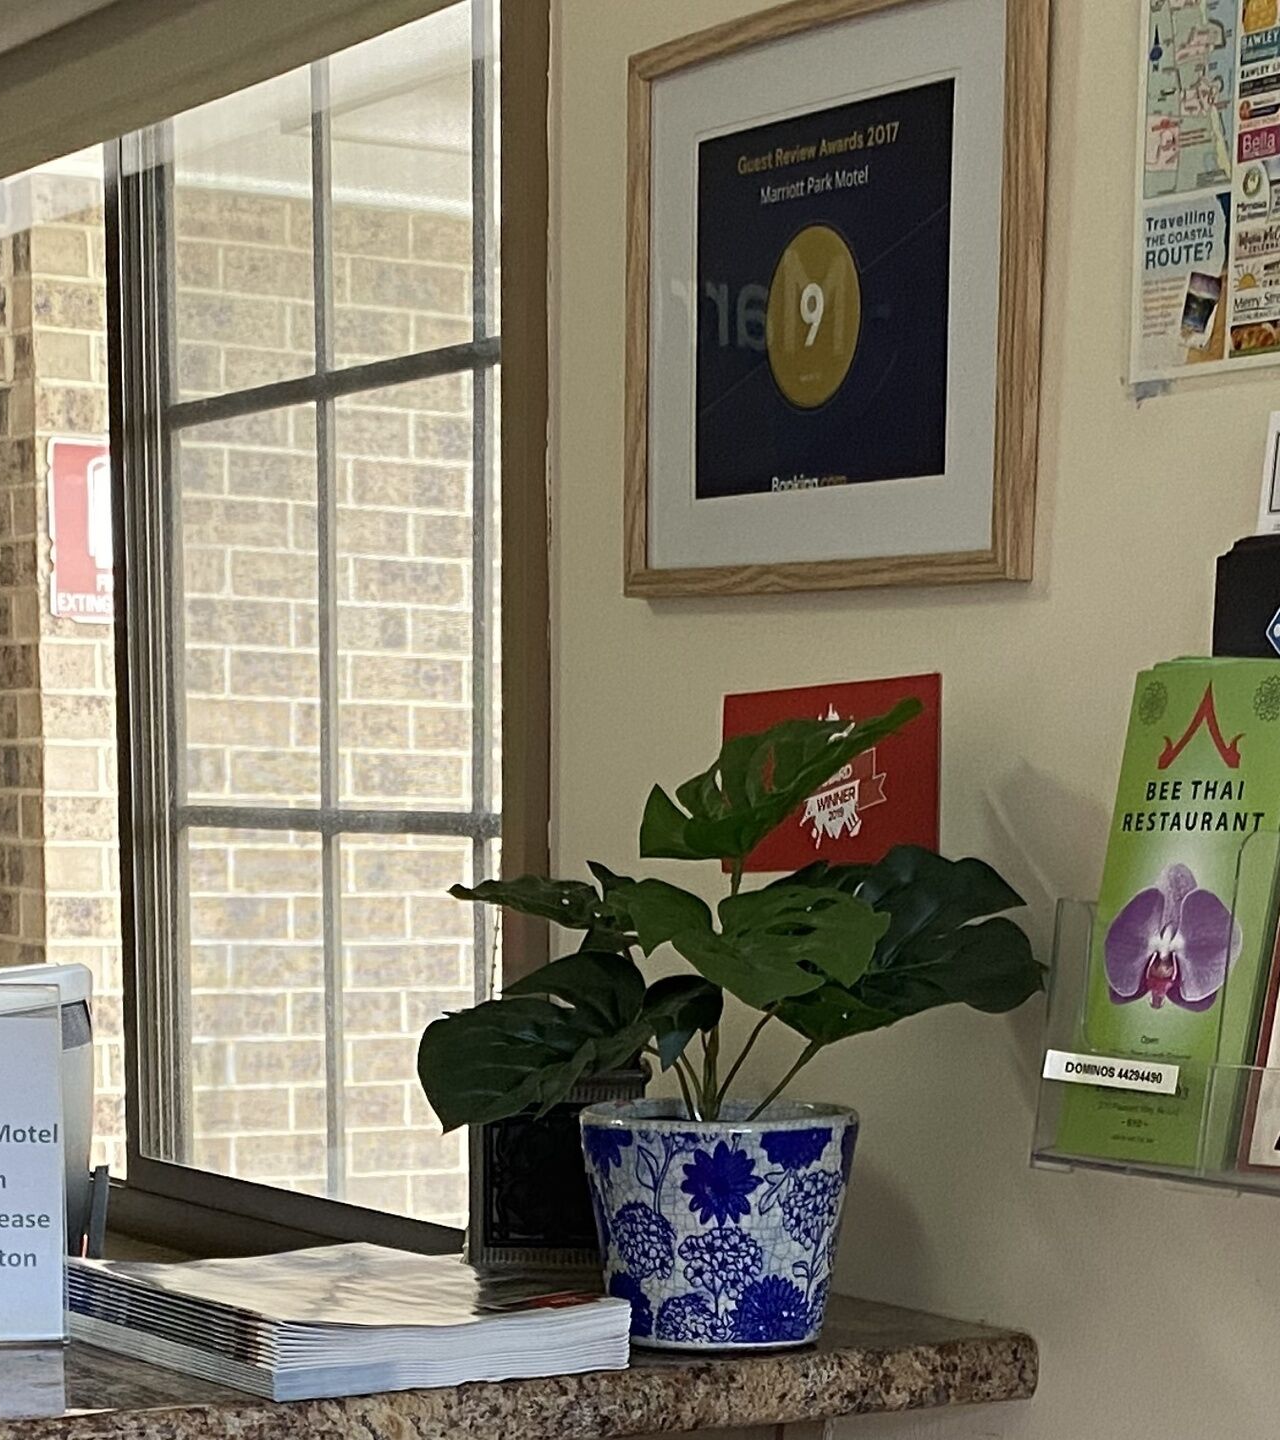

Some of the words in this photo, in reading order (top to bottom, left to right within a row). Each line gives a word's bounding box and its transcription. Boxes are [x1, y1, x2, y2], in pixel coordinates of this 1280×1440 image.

[738, 152, 772, 174] Guest
[775, 145, 816, 167] Review
[820, 131, 863, 156] Awards
[867, 121, 899, 146] 2017
[1242, 133, 1275, 152] Bella
[761, 179, 804, 204] Marriott
[807, 174, 832, 193] Park
[835, 165, 869, 188] Motel
[1146, 211, 1215, 232] Travelling
[1145, 233, 1167, 248] THE
[1170, 227, 1214, 243] COASTAL
[1145, 242, 1213, 270] ROUTE?
[800, 283, 824, 348] 9
[1146, 779, 1182, 801] BEE
[1191, 780, 1246, 801] THAI
[1122, 811, 1265, 833] RESTAURANT
[1065, 1061, 1115, 1078] DOMINOS
